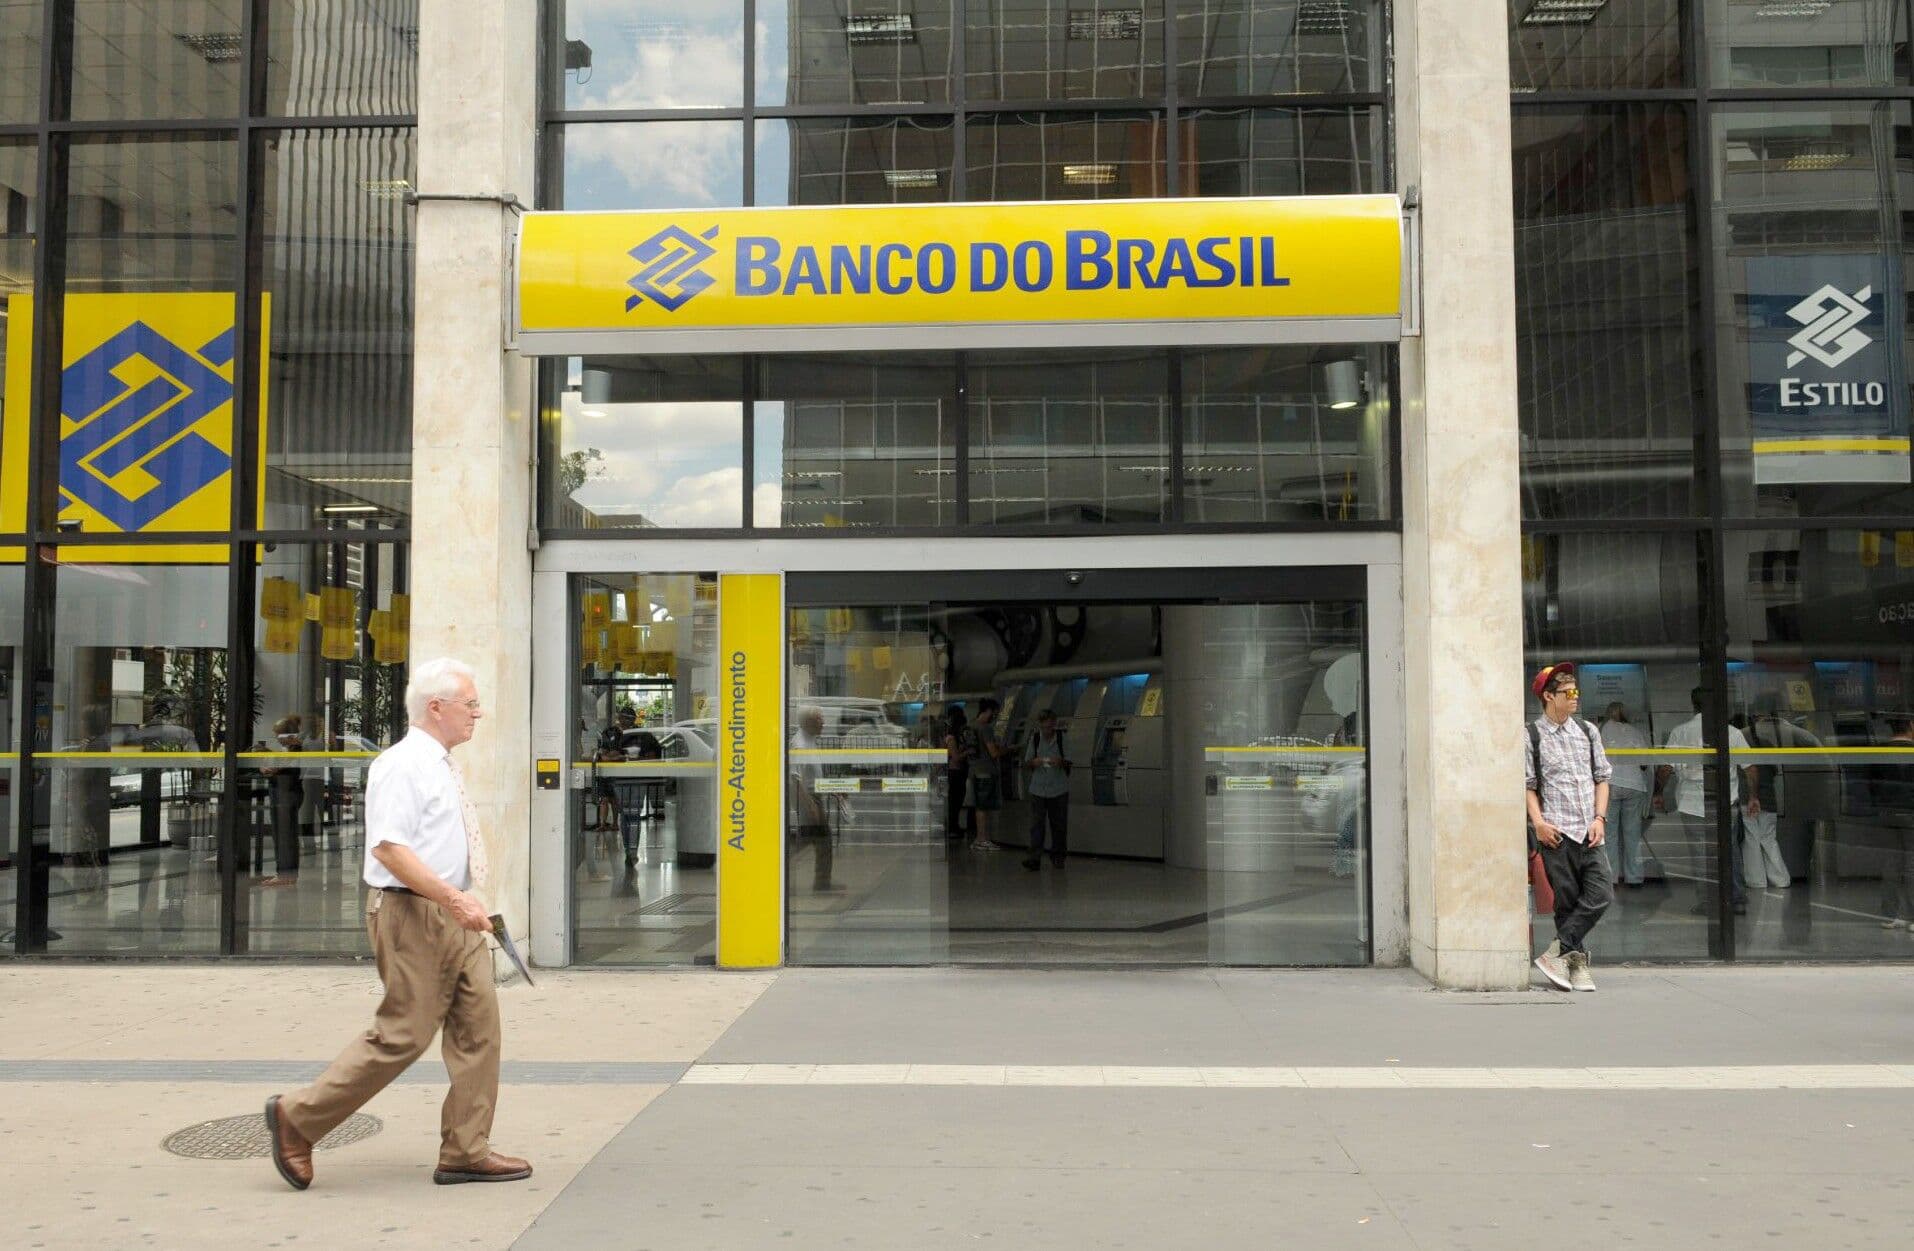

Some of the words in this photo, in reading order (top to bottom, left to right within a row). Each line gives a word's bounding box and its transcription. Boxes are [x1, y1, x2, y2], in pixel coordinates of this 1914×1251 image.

[735, 236, 956, 296] BANCO
[970, 240, 1053, 293] DO
[1066, 229, 1290, 290] BRASIL
[1780, 378, 1884, 407] ESTILO
[728, 651, 746, 851] Auto-Atendimento
